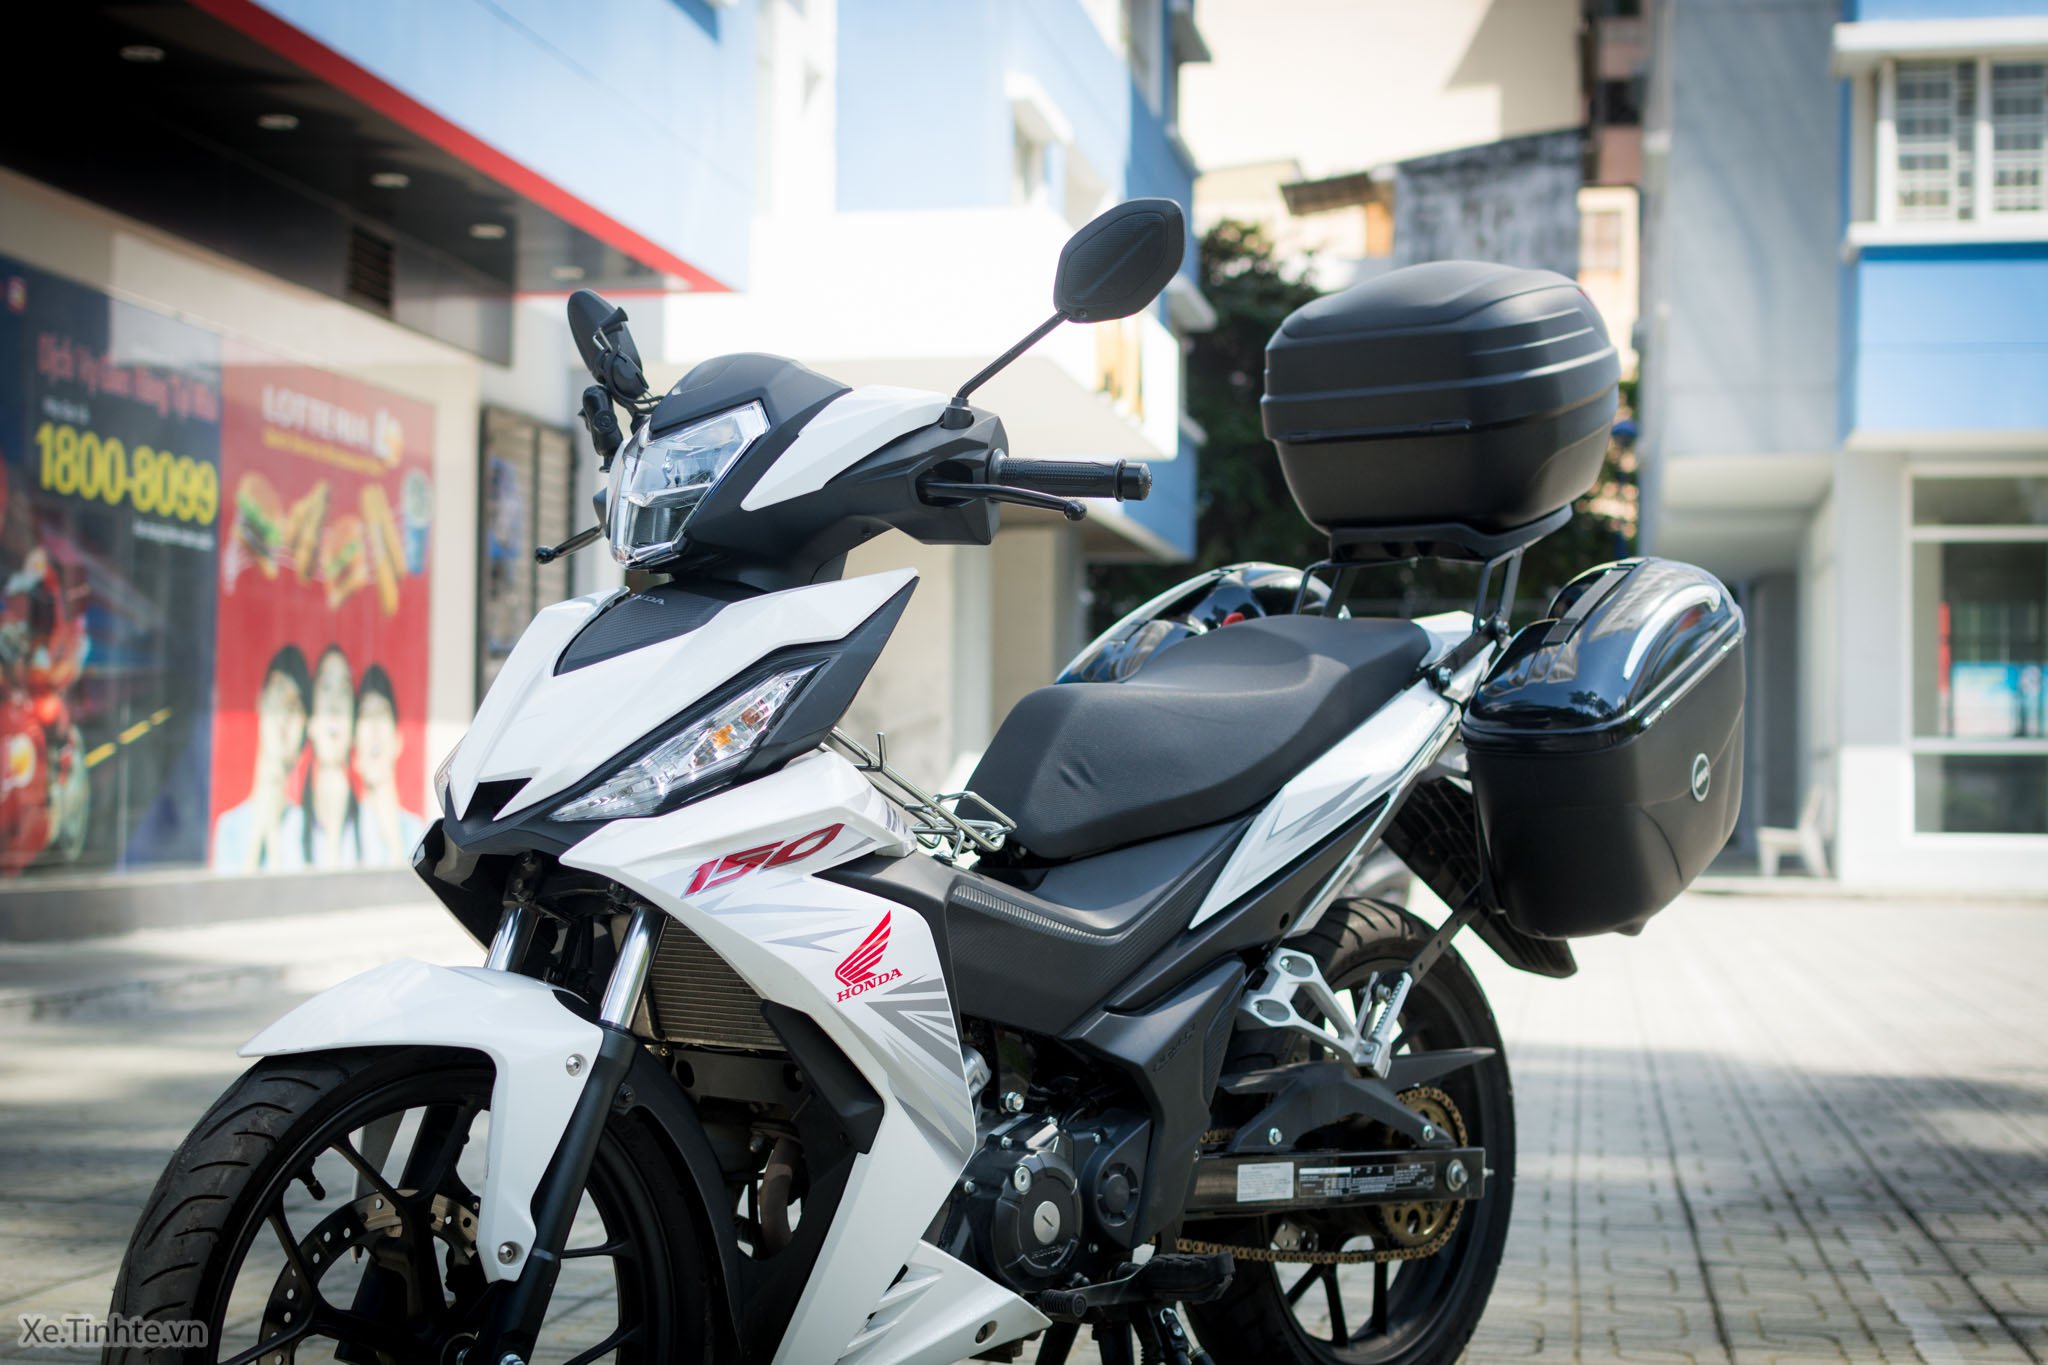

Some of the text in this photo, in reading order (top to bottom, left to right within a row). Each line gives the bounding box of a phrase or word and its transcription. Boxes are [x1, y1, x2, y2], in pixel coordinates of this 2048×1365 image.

[36, 422, 218, 525] 1800-8099
[681, 822, 845, 899] 150
[836, 967, 904, 1003] HONDA
